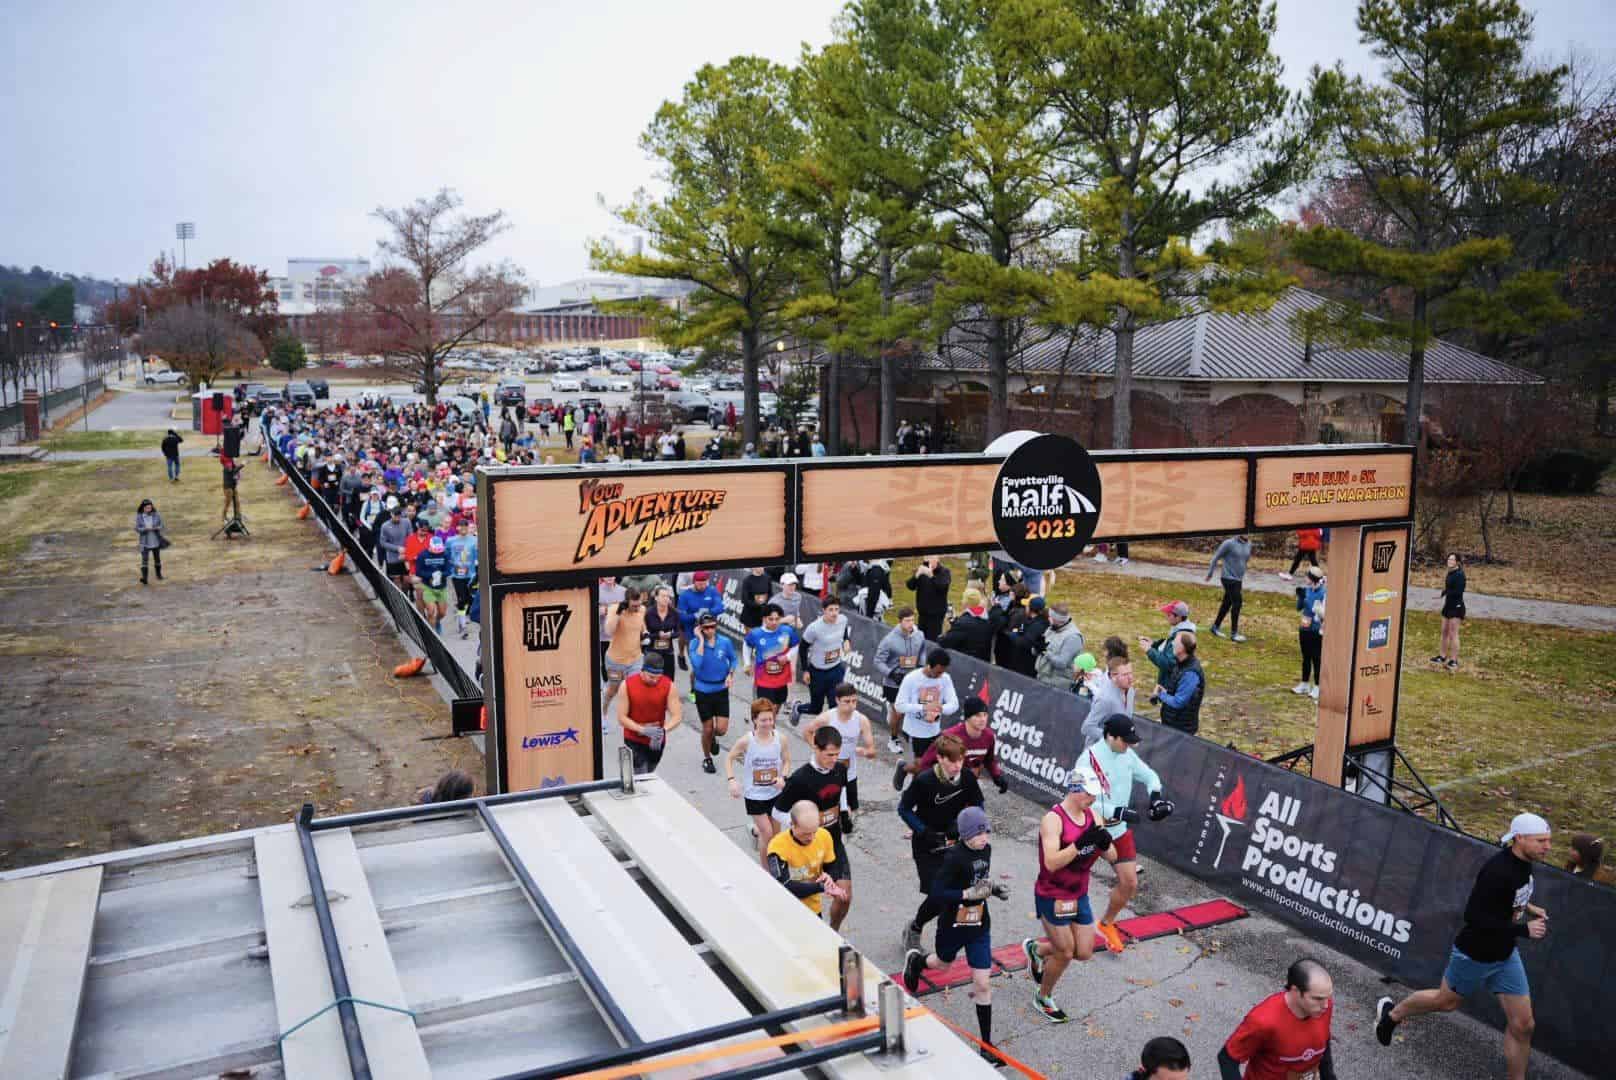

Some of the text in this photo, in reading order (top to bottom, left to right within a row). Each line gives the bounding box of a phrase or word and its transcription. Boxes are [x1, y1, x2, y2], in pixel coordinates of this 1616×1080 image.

[1001, 474, 1064, 488] Fayetteville
[1292, 469, 1377, 487] FUN RUN 5K
[578, 479, 624, 514] YOUR
[1001, 485, 1064, 508] half
[1266, 485, 1407, 508] 10K HALF MARATHON
[1001, 504, 1064, 518] MARATHON
[572, 489, 727, 564] ADVENTURE
[629, 509, 712, 561] AWAITS
[1025, 518, 1076, 540] 2023
[533, 610, 564, 647] FAY
[525, 674, 562, 689] UAMS
[530, 685, 567, 700] Health
[996, 689, 1024, 715] All
[990, 709, 1044, 747] Sports
[522, 734, 562, 749] Lewis
[1257, 791, 1302, 826] All
[1251, 817, 1337, 873] Sports
[1241, 845, 1413, 943] Productions
[1241, 877, 1401, 960] www.allsportsproductionsinc.com
